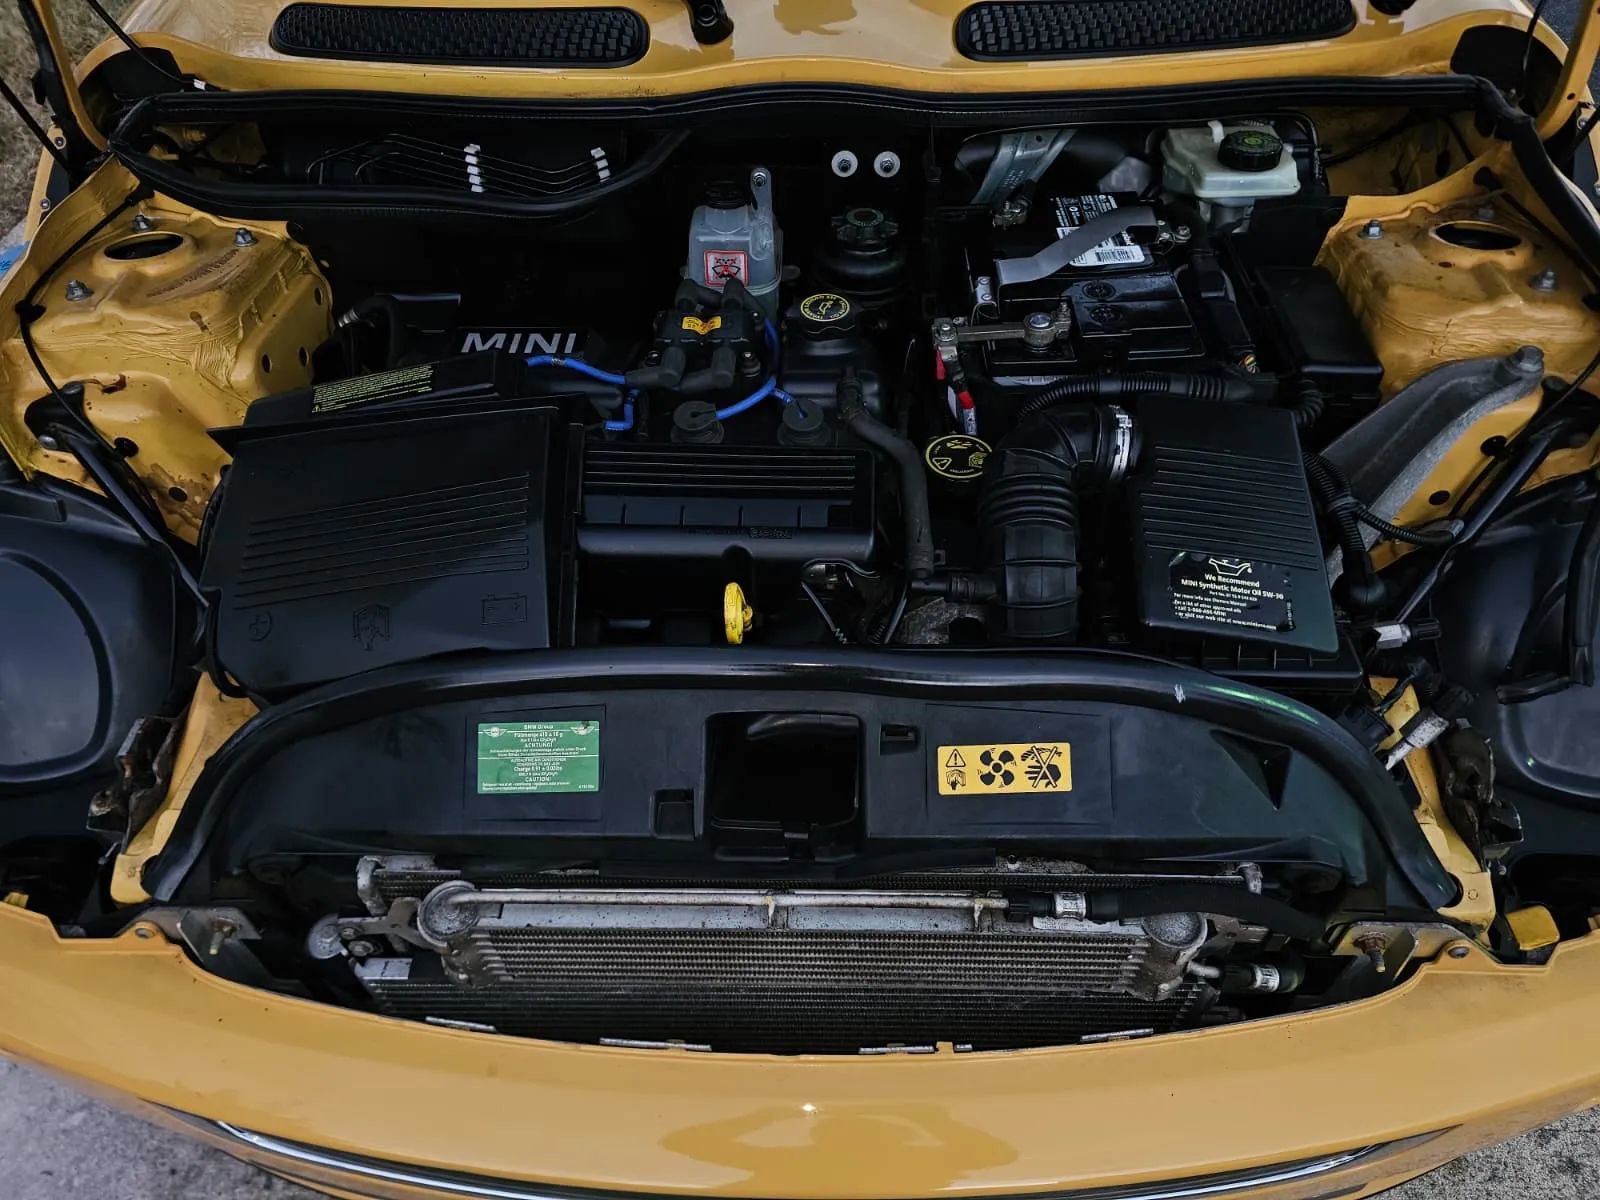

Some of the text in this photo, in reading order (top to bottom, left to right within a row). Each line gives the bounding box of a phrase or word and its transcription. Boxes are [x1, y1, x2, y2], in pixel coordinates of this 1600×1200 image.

[461, 333, 577, 353] MINI
[1181, 579, 1198, 587] MINI
[1199, 581, 1229, 592] Synthetic
[1231, 585, 1251, 595] Motor
[1252, 589, 1262, 597] Oil
[1262, 590, 1284, 600] 5W-30
[1205, 573, 1260, 588] We Recommend
